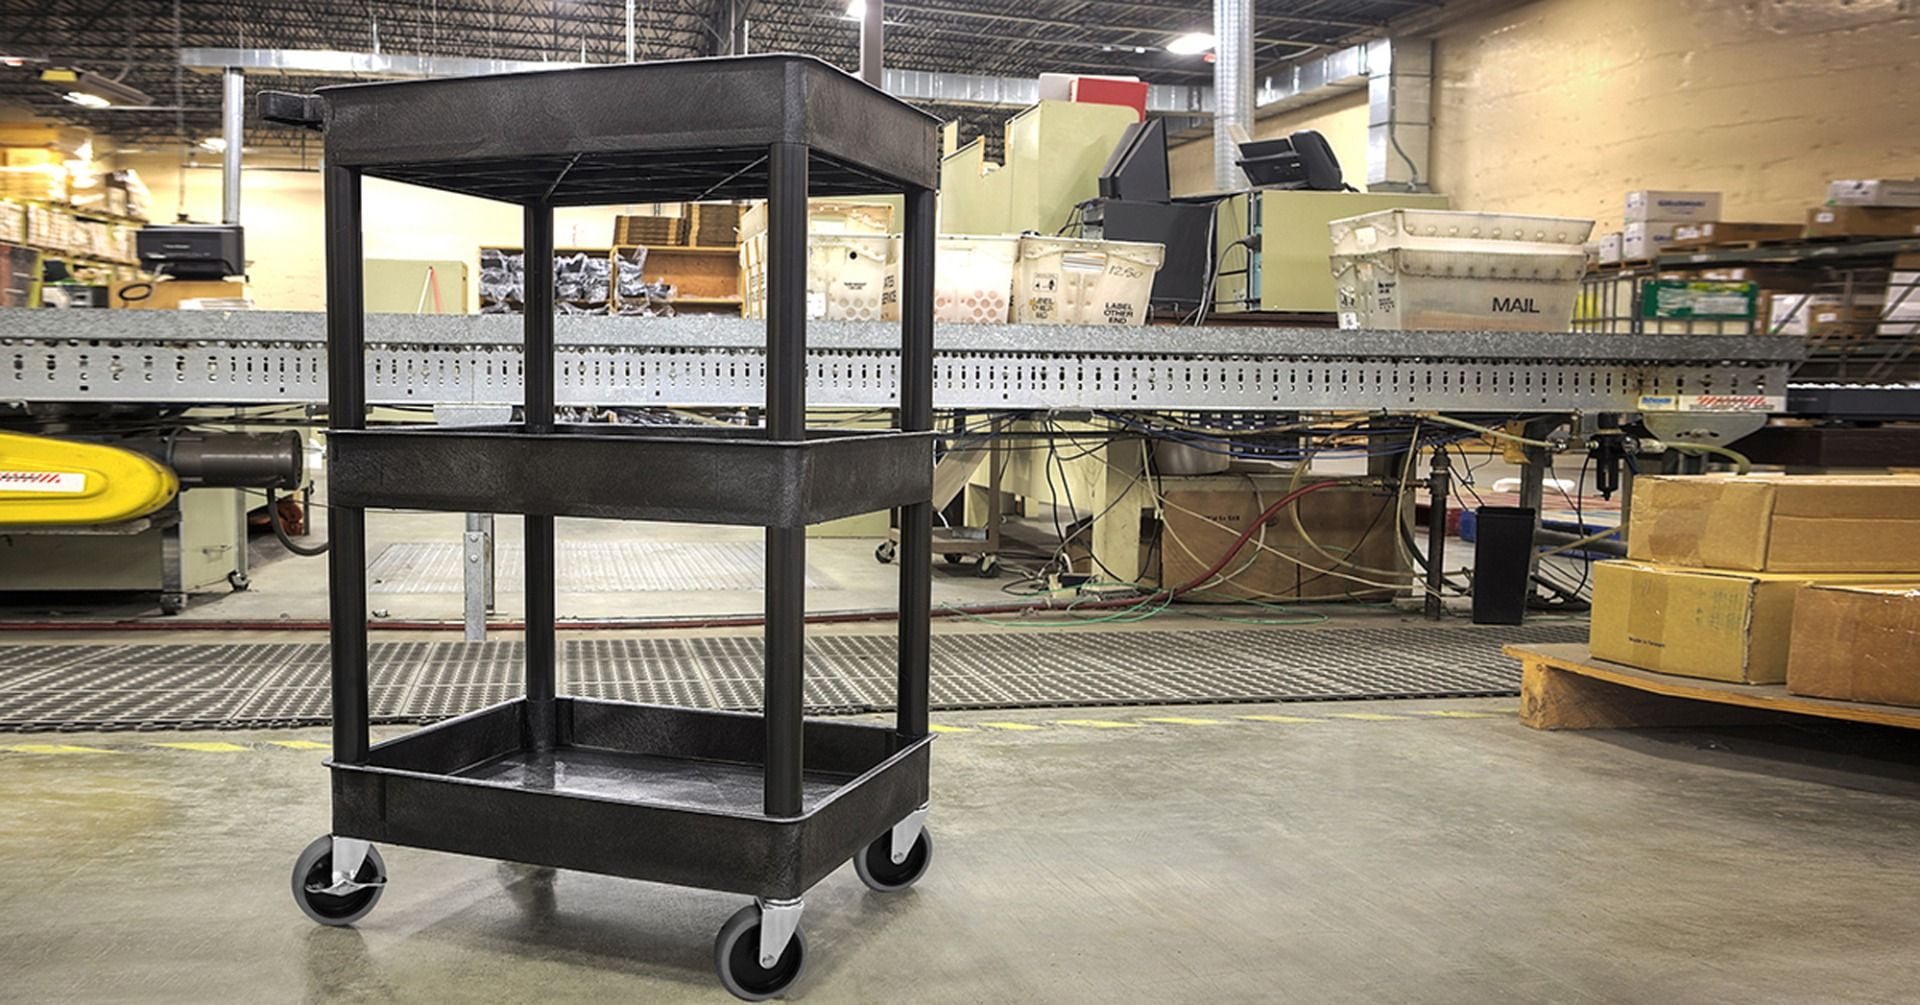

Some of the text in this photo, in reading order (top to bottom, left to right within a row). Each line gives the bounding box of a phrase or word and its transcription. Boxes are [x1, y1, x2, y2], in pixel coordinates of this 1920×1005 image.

[1105, 302, 1133, 310] LABEL
[1492, 297, 1540, 313] MAIL
[1103, 309, 1134, 318] OTHER
[1108, 316, 1128, 324] END
